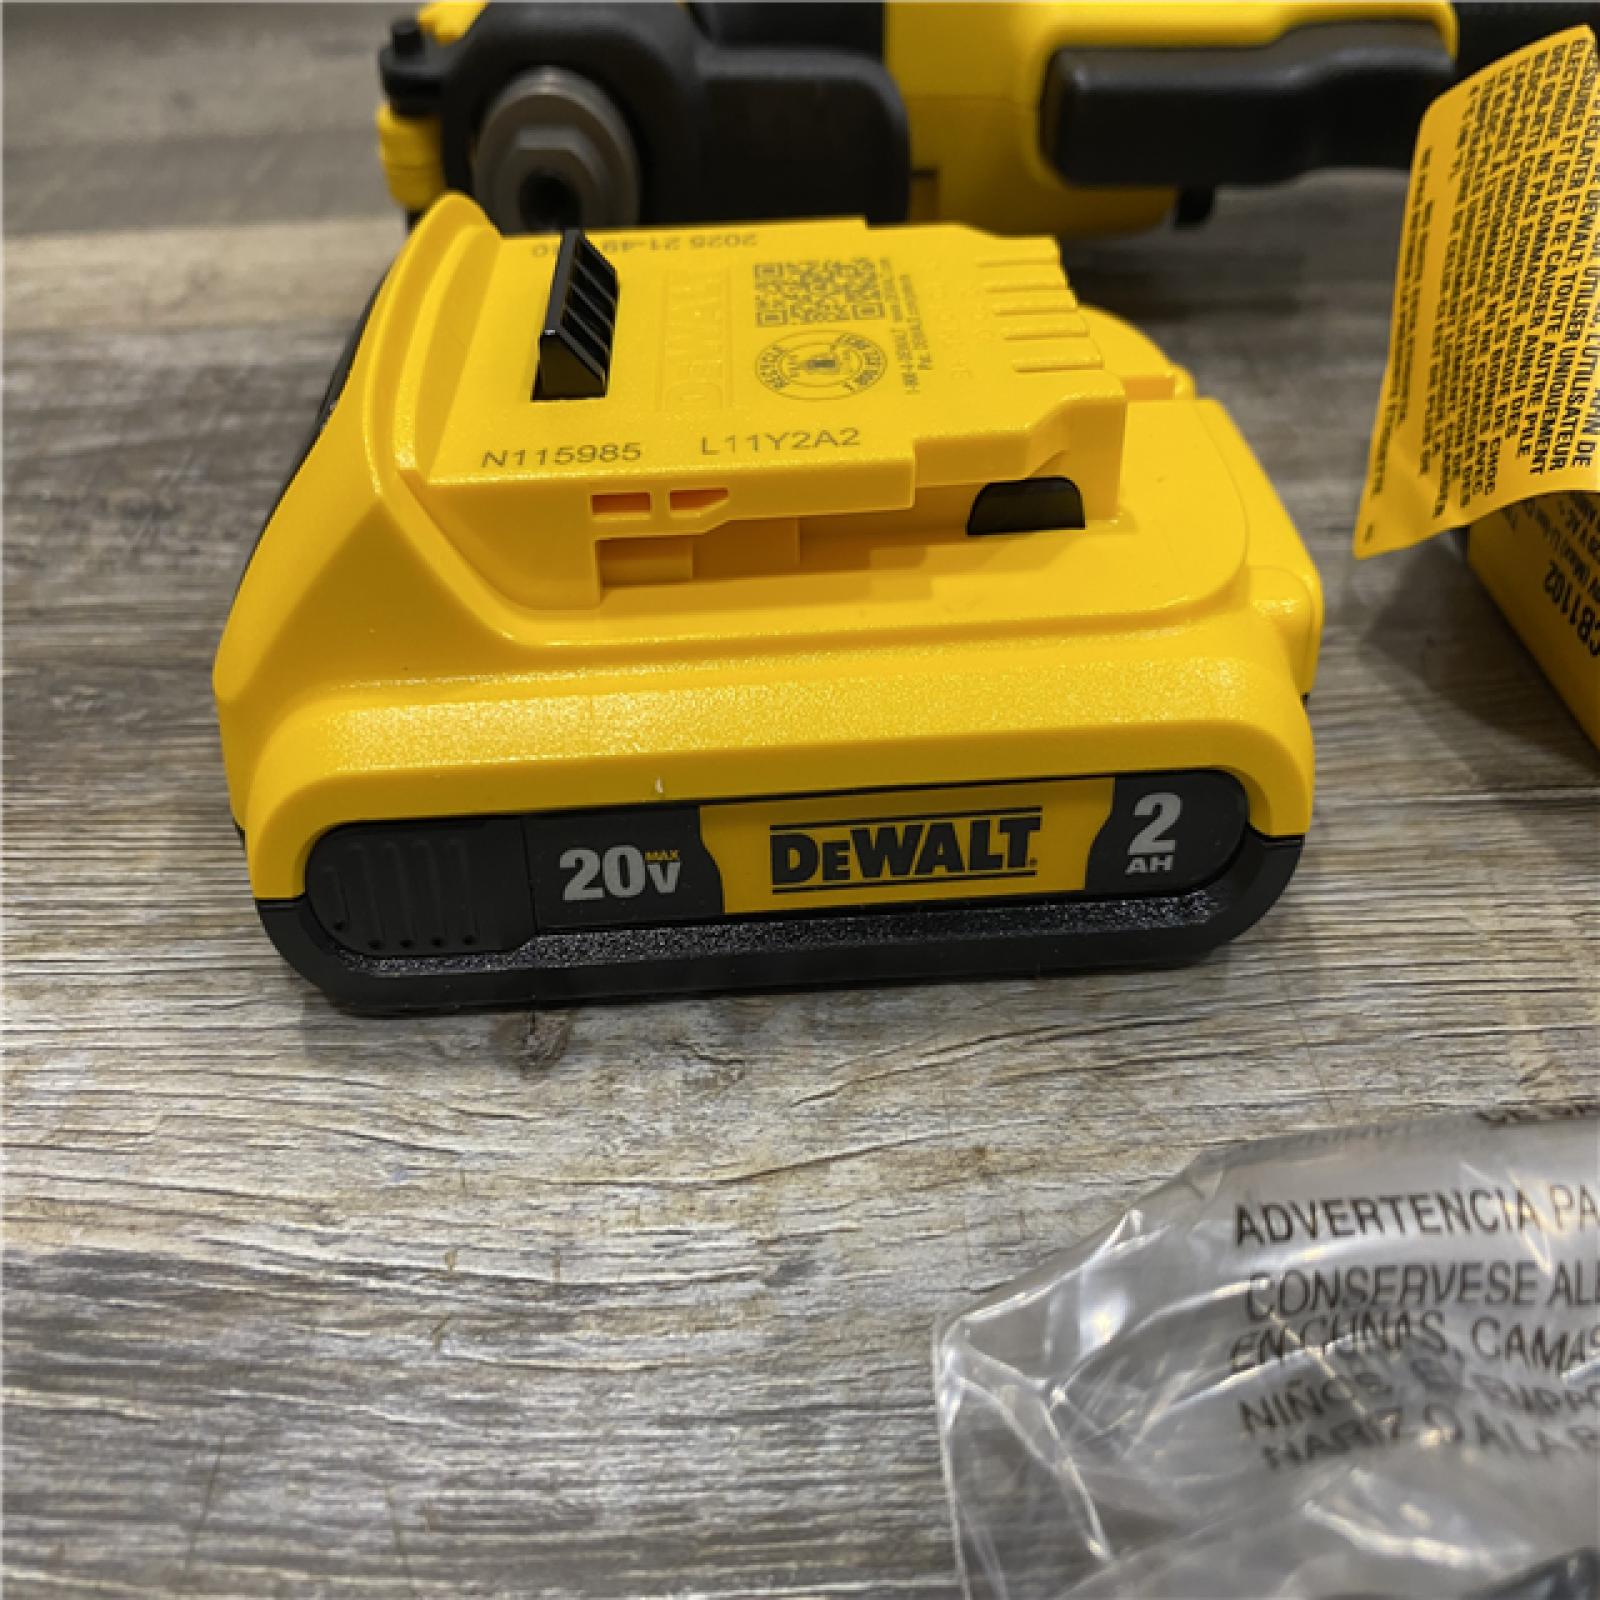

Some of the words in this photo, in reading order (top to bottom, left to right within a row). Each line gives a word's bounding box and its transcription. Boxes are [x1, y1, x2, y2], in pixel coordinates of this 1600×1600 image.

[1544, 269, 1579, 335] TOUTE
[1562, 258, 1600, 342] UTILISER
[1530, 343, 1579, 475] UNIQUEMENT
[1550, 329, 1600, 470] LUTILISATEUR
[480, 441, 641, 468] N115985
[700, 427, 862, 456] L11Y2A2
[1572, 439, 1596, 468] DE
[1127, 792, 1181, 855] 2
[1125, 854, 1173, 875] AH
[1234, 1187, 1541, 1247] ADVERTENCIA
[1246, 1258, 1537, 1323] CONSERVESE
